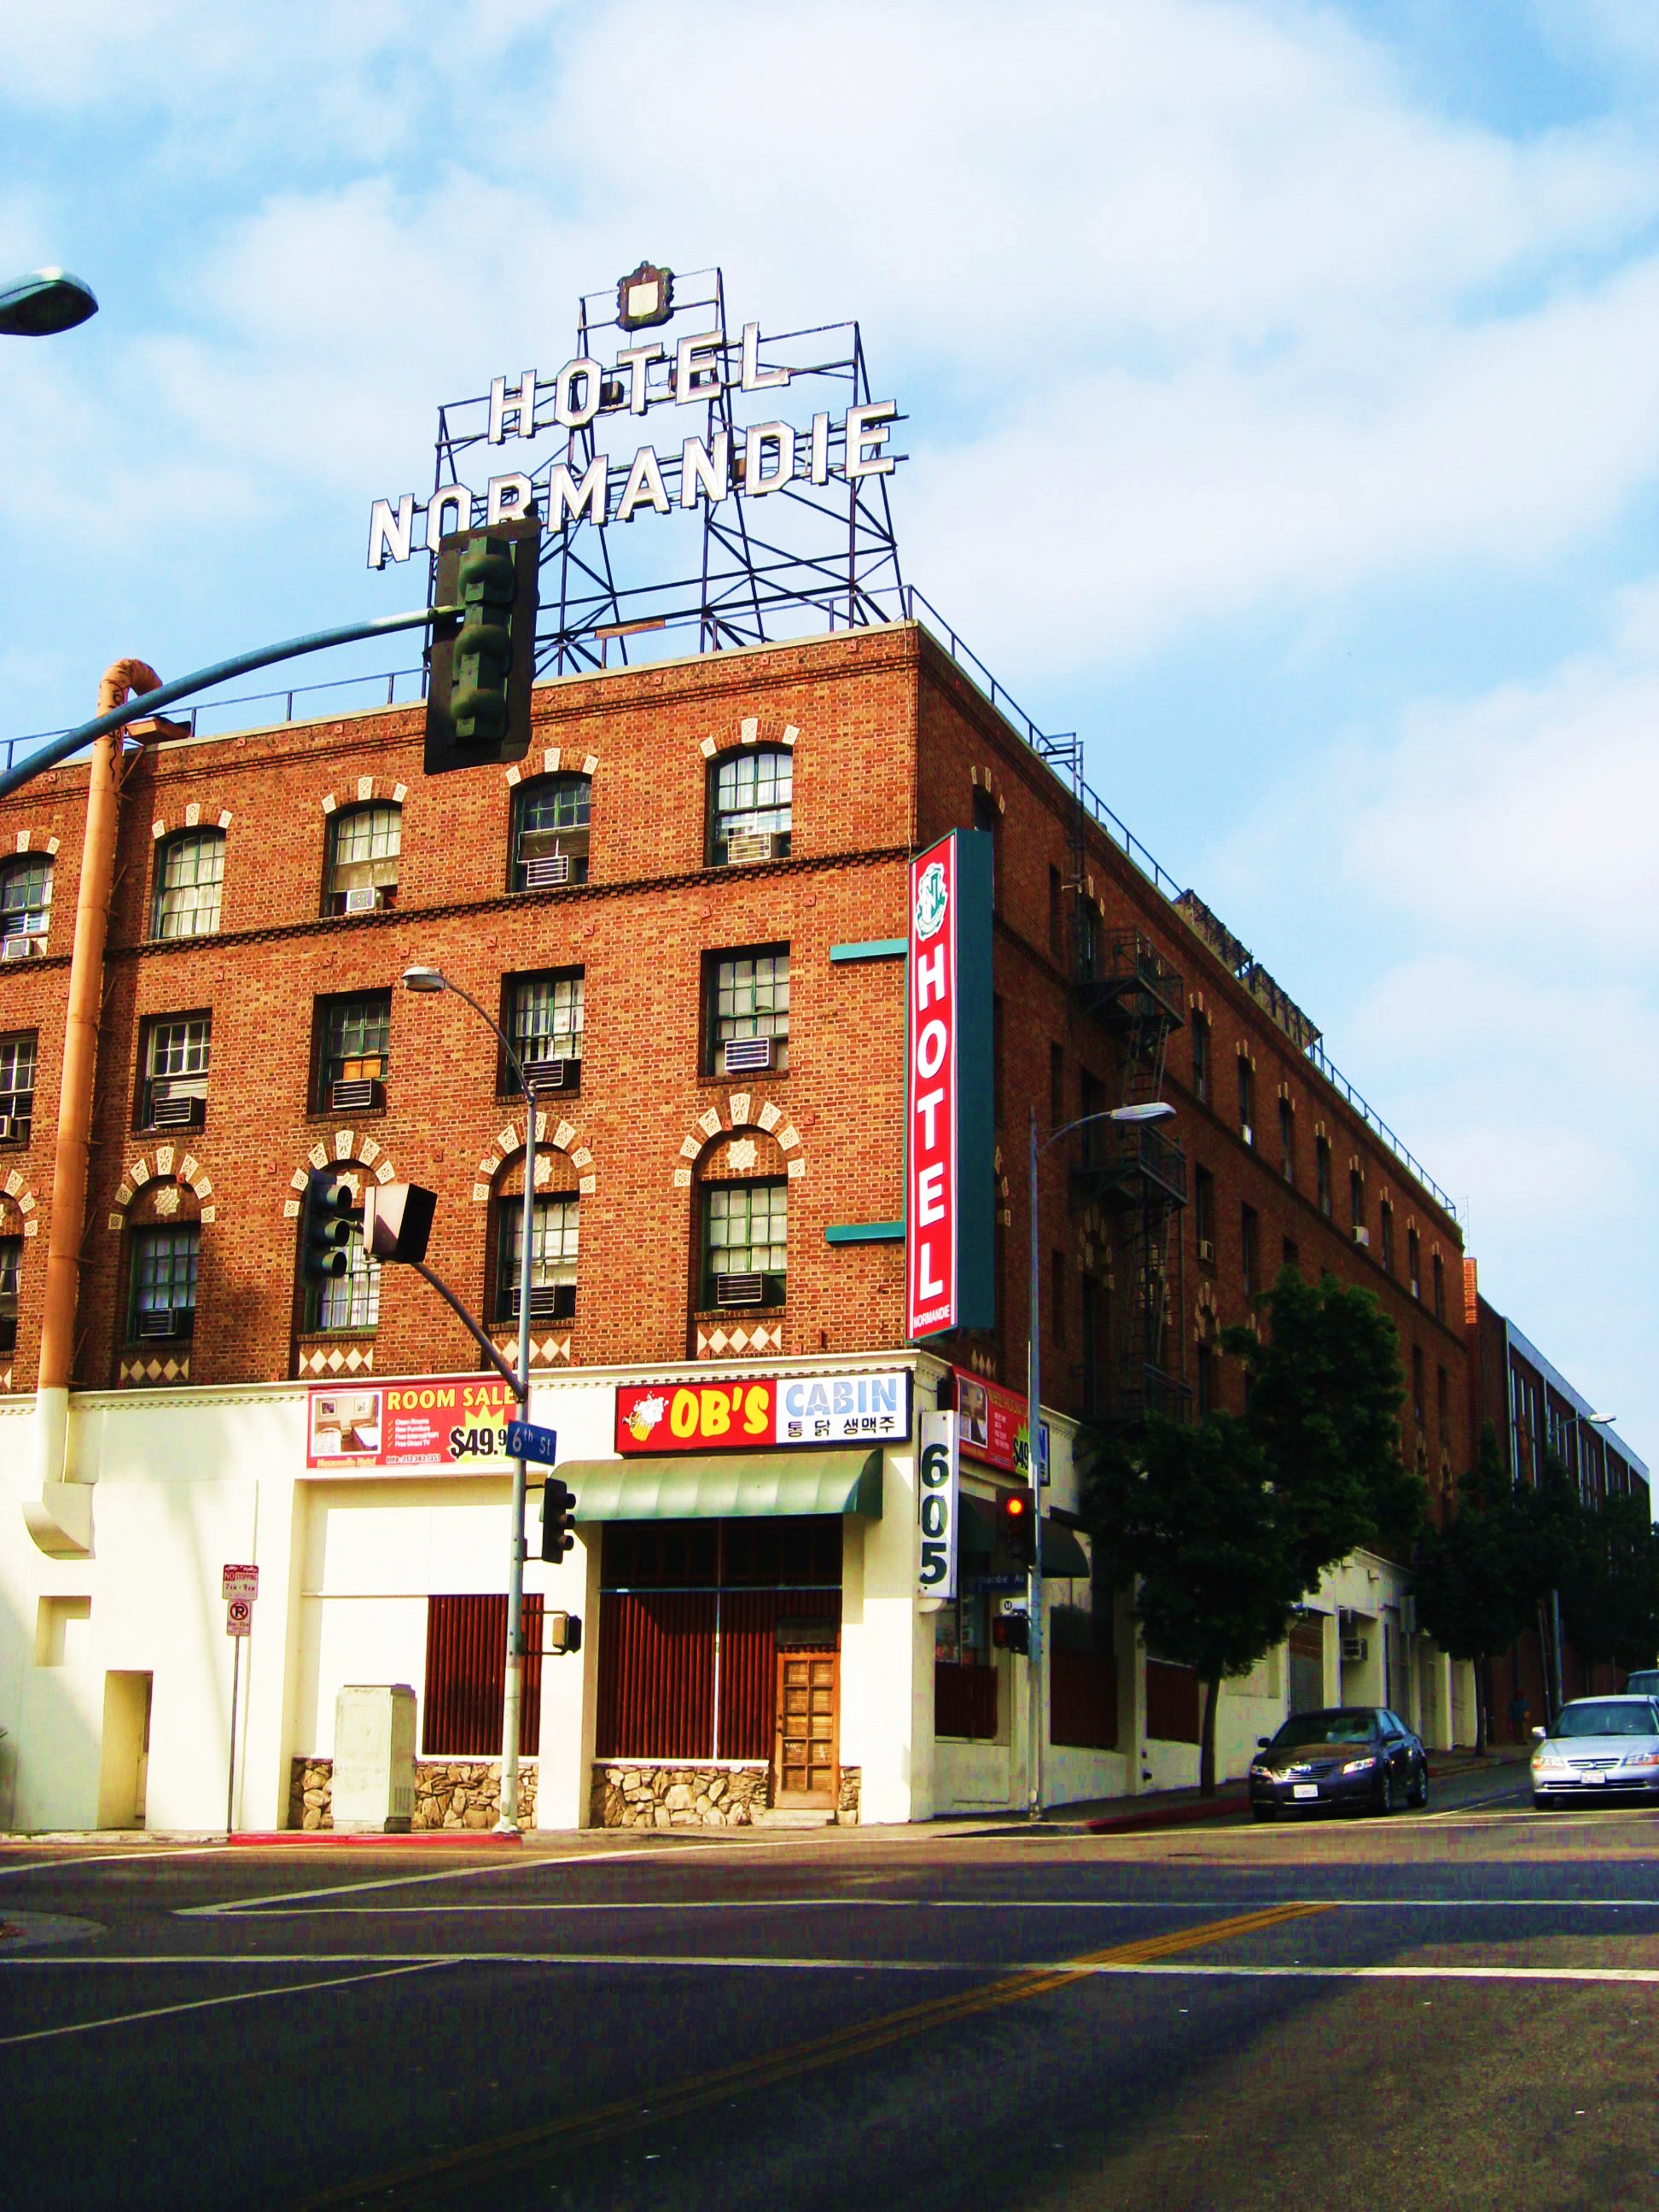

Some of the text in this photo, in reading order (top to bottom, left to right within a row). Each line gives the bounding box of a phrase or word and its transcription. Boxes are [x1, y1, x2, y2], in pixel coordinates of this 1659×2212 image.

[488, 322, 789, 444] HOTEL
[367, 399, 897, 569] NORMANDIE
[917, 943, 947, 1301] HOTEL
[913, 1304, 950, 1329] NORMANDIE
[387, 1384, 516, 1411] ROOM SALE
[670, 1378, 897, 1438] OB'S CABIN
[451, 1428, 507, 1458] $49.9
[513, 1427, 551, 1457] 6th St
[788, 1416, 895, 1438] 통 닭 생맥주
[920, 1443, 950, 1586] 605
